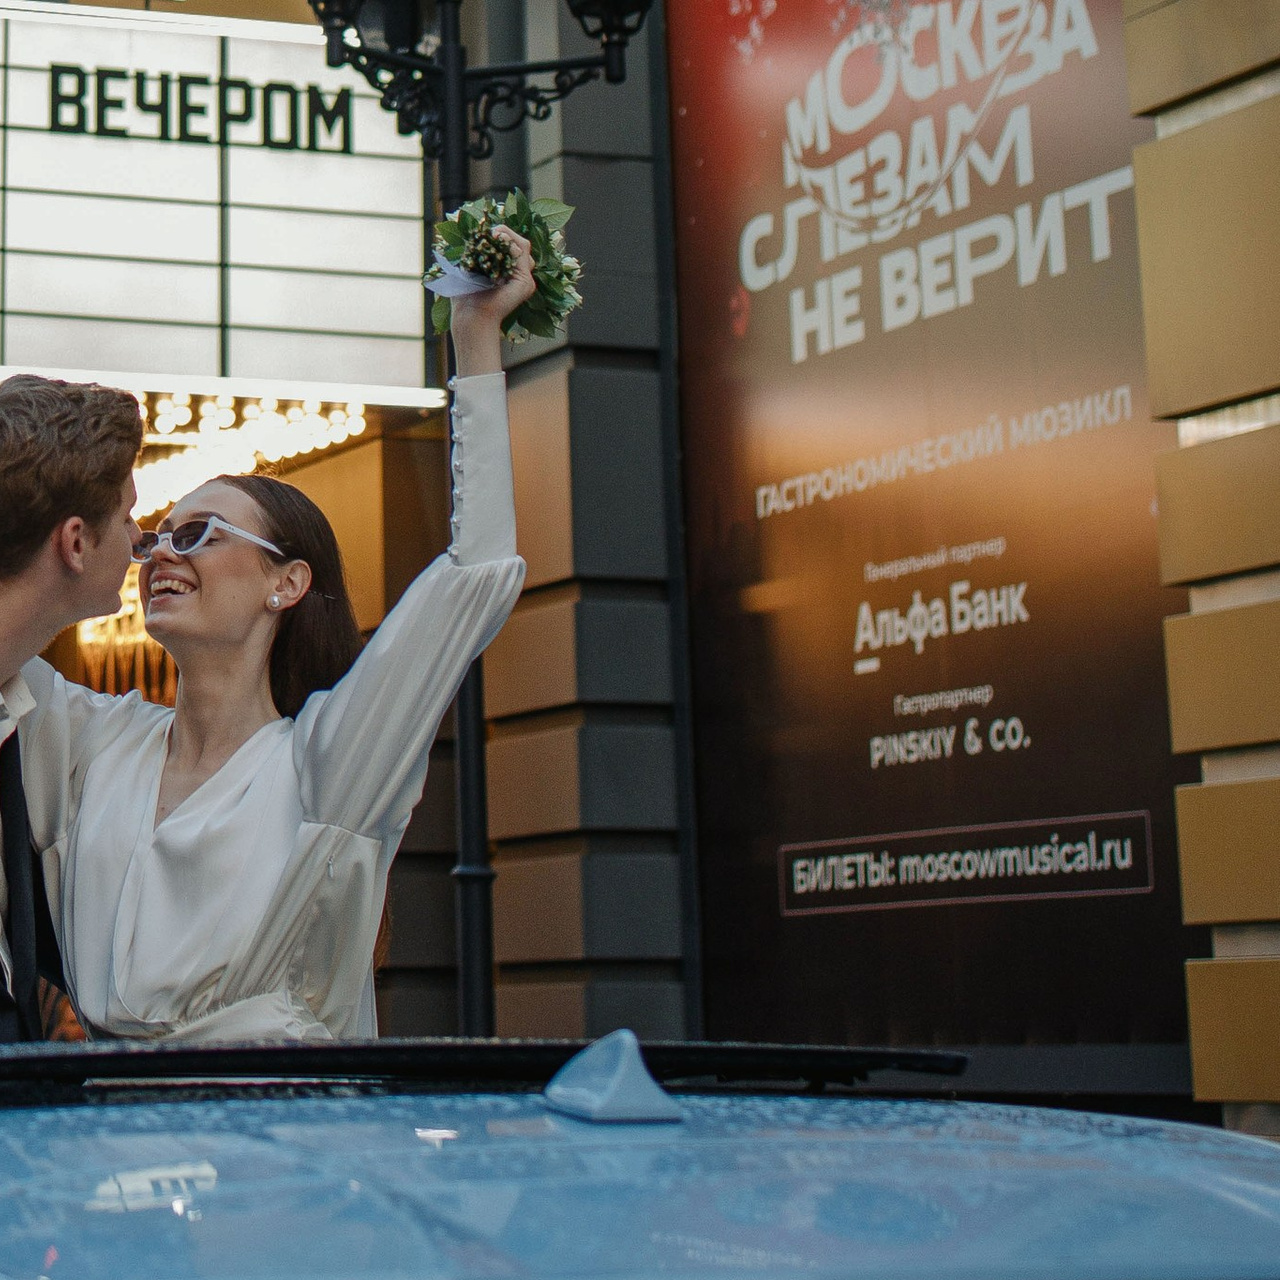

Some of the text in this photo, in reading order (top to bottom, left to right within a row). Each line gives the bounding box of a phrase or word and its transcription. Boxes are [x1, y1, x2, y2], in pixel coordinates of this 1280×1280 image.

[49, 63, 355, 155] ВЕЧЕРОМ
[738, 103, 1035, 292] СЛЕЗАМ
[789, 165, 1135, 365] НЕ ВЕРИТ
[755, 383, 1133, 520] ГАСТРОНОМИЧЕСКИЙ МЮЗИКЛ
[863, 547, 949, 583] Генеральный
[869, 724, 957, 769] PINSKIY
[963, 717, 983, 756] &
[792, 830, 1134, 895] БИЛЕТЫ: moscowmusical.ru
